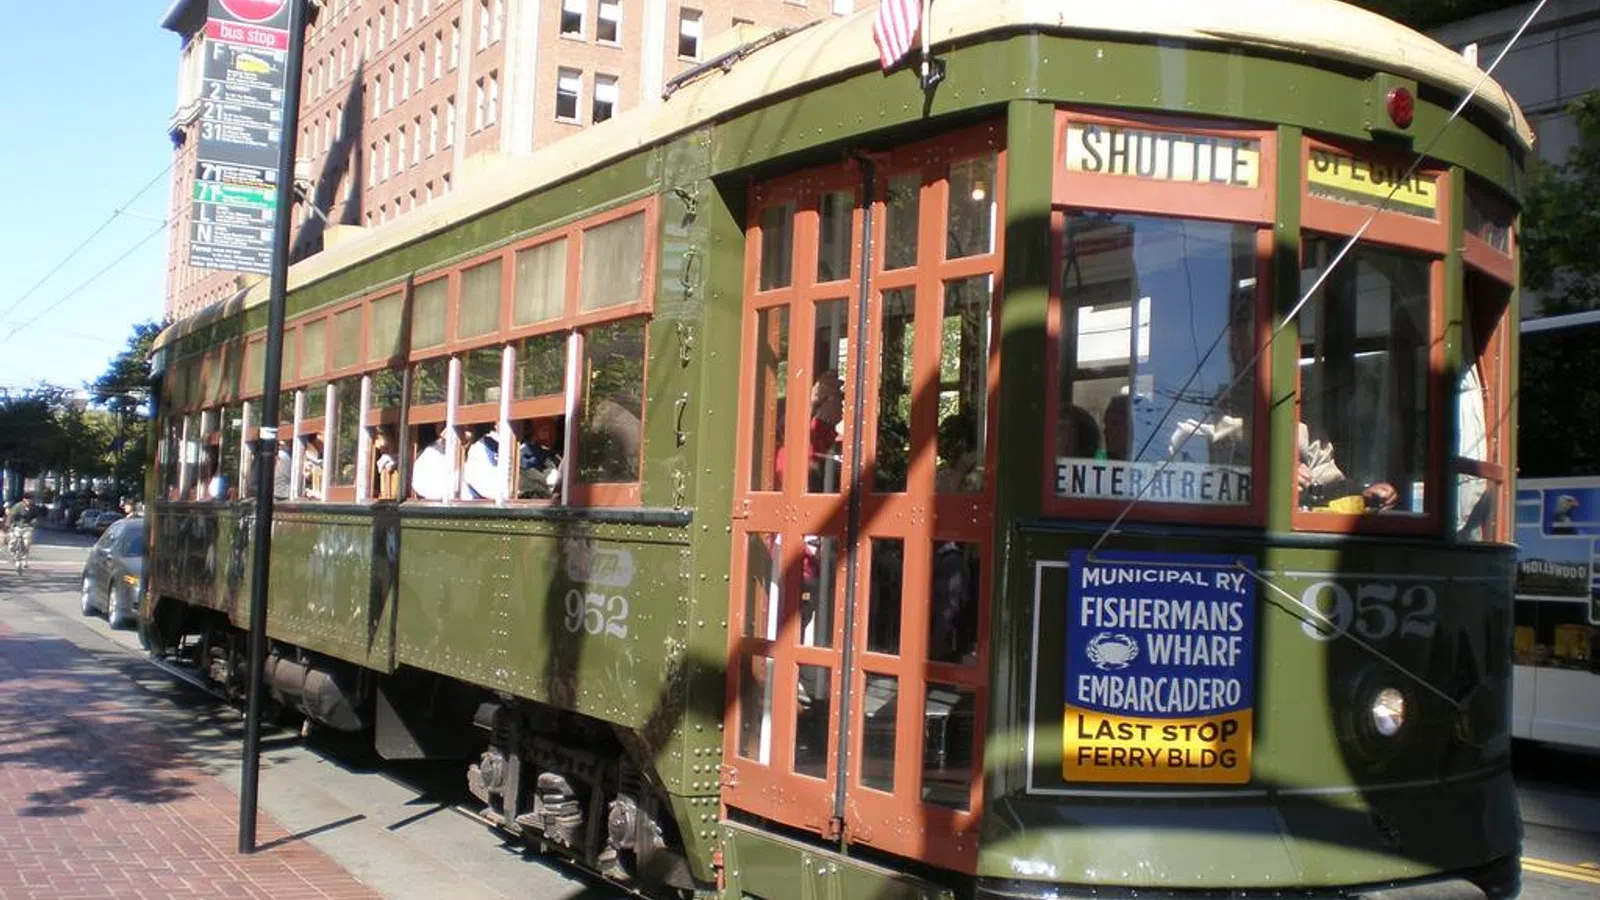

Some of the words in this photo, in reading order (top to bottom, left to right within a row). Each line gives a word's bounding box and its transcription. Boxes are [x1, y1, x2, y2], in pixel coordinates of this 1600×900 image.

[220, 21, 244, 39] bus
[246, 28, 276, 47] stop
[213, 43, 225, 60] F
[210, 83, 221, 99] 2
[203, 102, 223, 120] 21
[201, 122, 222, 141] 31
[1081, 125, 1249, 186] SHUTTLE
[201, 163, 222, 181] 71
[200, 203, 211, 222] L
[197, 224, 212, 243] N
[1055, 464, 1144, 496] ENTER
[1151, 469, 1177, 498] AT
[1182, 469, 1251, 501] REAR
[1081, 567, 1209, 589] MUNICIPAL
[1215, 572, 1247, 595] RY.
[1521, 560, 1587, 579] HOLLYWOOD
[564, 588, 629, 639] 952
[1081, 596, 1244, 632] FISHERMANS
[1301, 580, 1438, 641] 952
[1147, 633, 1242, 667] WHARF
[1077, 674, 1241, 713] EMBARCADERO
[1078, 713, 1153, 742] LAST
[1162, 719, 1239, 743] STOP
[1077, 746, 1164, 768] FERRY
[1167, 748, 1237, 769] BLDG
